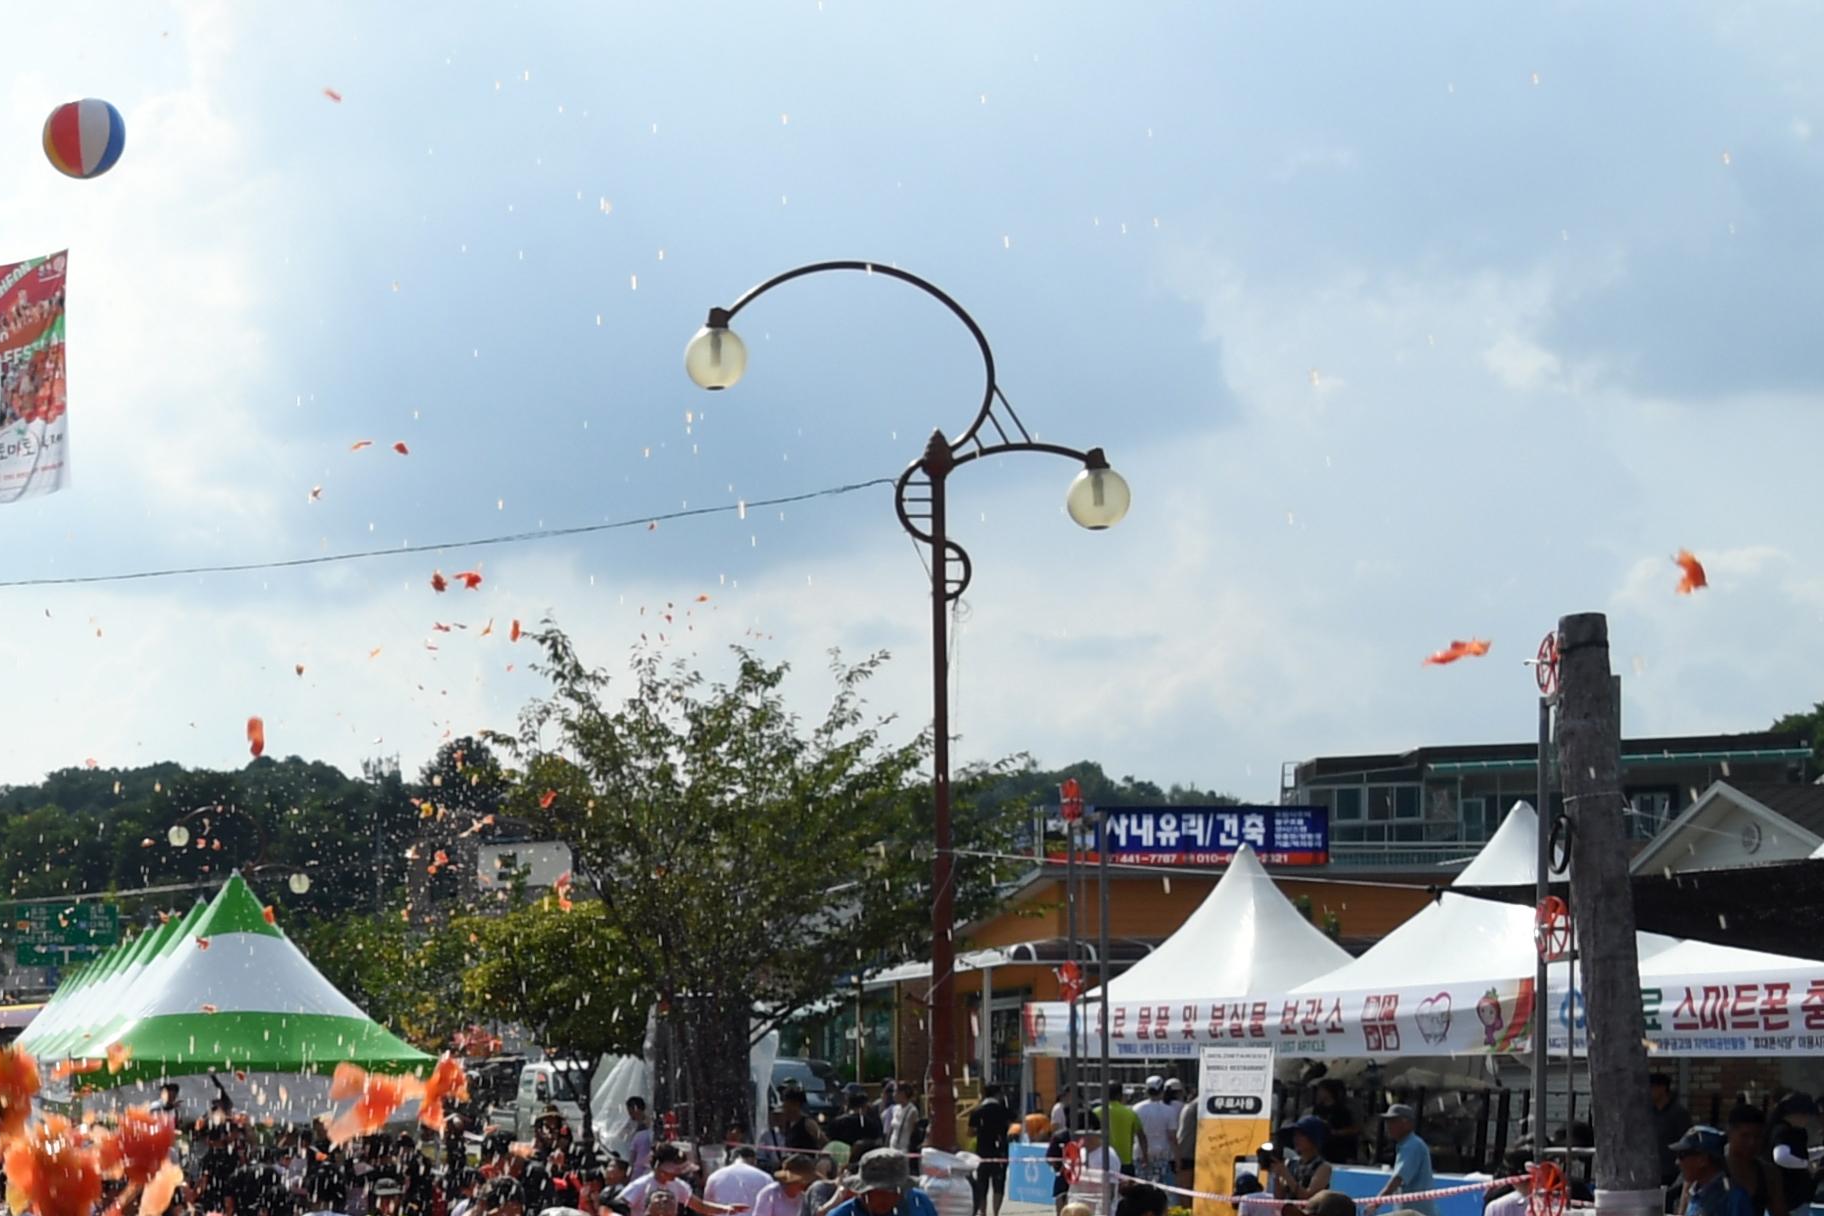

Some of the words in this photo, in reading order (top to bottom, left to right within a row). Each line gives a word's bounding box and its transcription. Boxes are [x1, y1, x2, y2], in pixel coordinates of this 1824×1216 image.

[1105, 813, 1266, 847] 사내유리/건축
[1119, 853, 1177, 864] 441-7787
[1136, 1004, 1170, 1039] 물품
[1182, 1003, 1197, 1038] 및
[1208, 1002, 1267, 1038] 분실물
[1280, 997, 1345, 1035] 보관소
[1673, 983, 1791, 1031] 스마트폰
[1214, 1097, 1255, 1110] 무료사용
